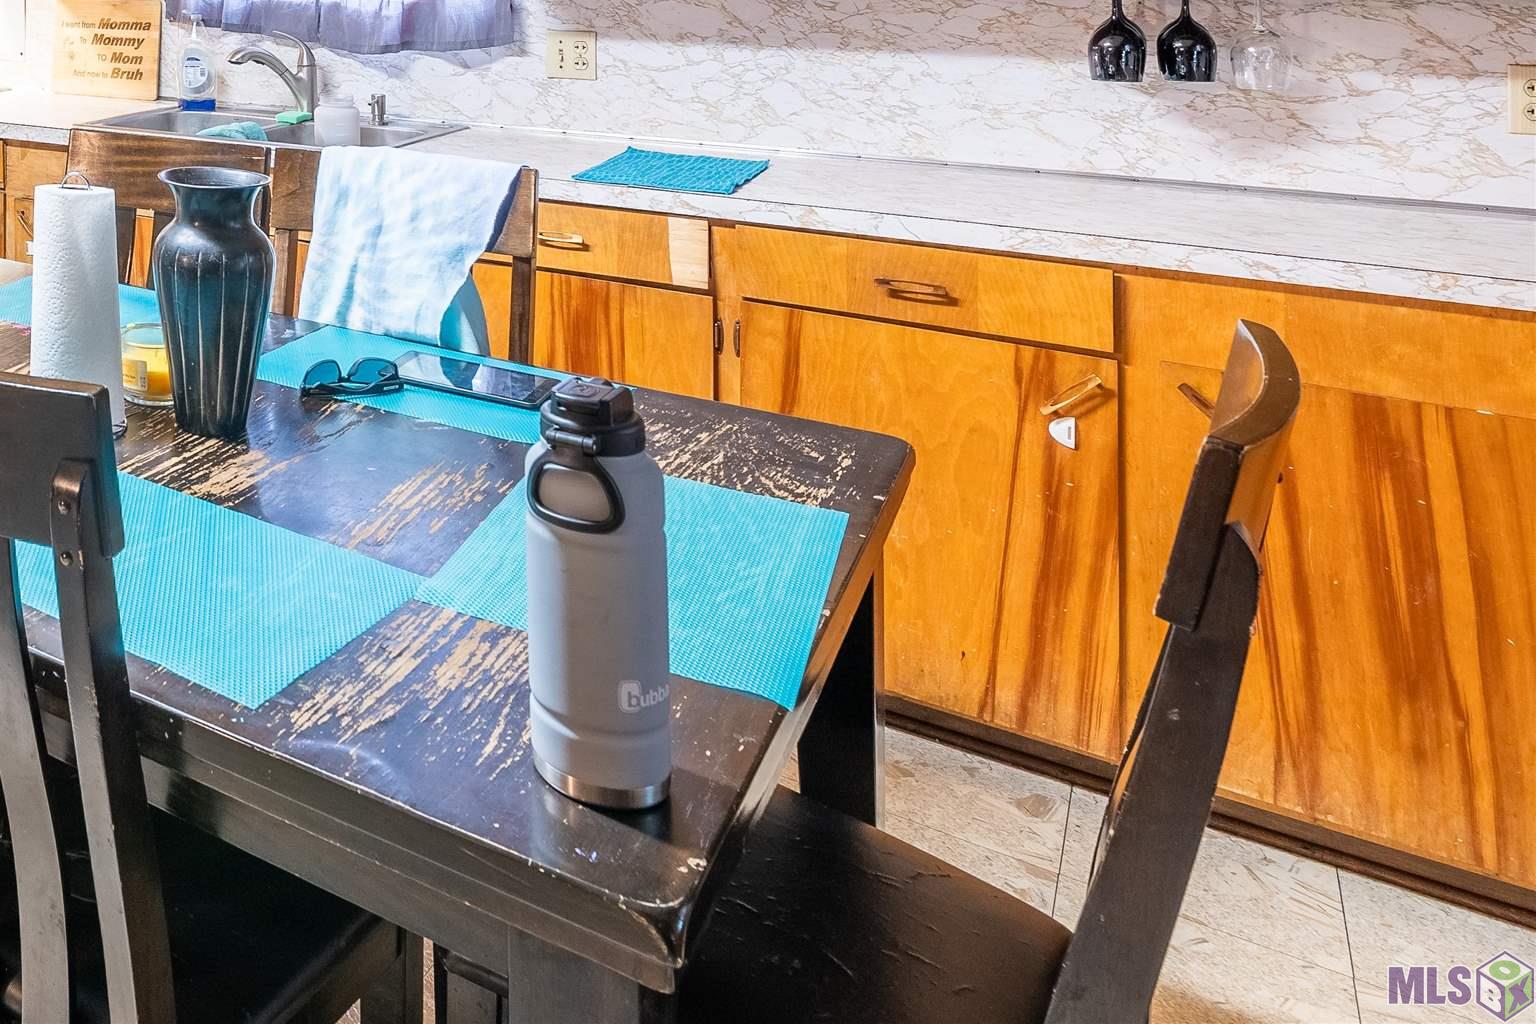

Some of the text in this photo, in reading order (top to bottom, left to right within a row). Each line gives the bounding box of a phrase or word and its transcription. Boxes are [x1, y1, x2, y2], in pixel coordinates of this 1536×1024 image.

[97, 17, 152, 31] Momma
[91, 33, 145, 50] Mommy
[110, 51, 144, 65] Mom
[110, 67, 144, 81] Bruh
